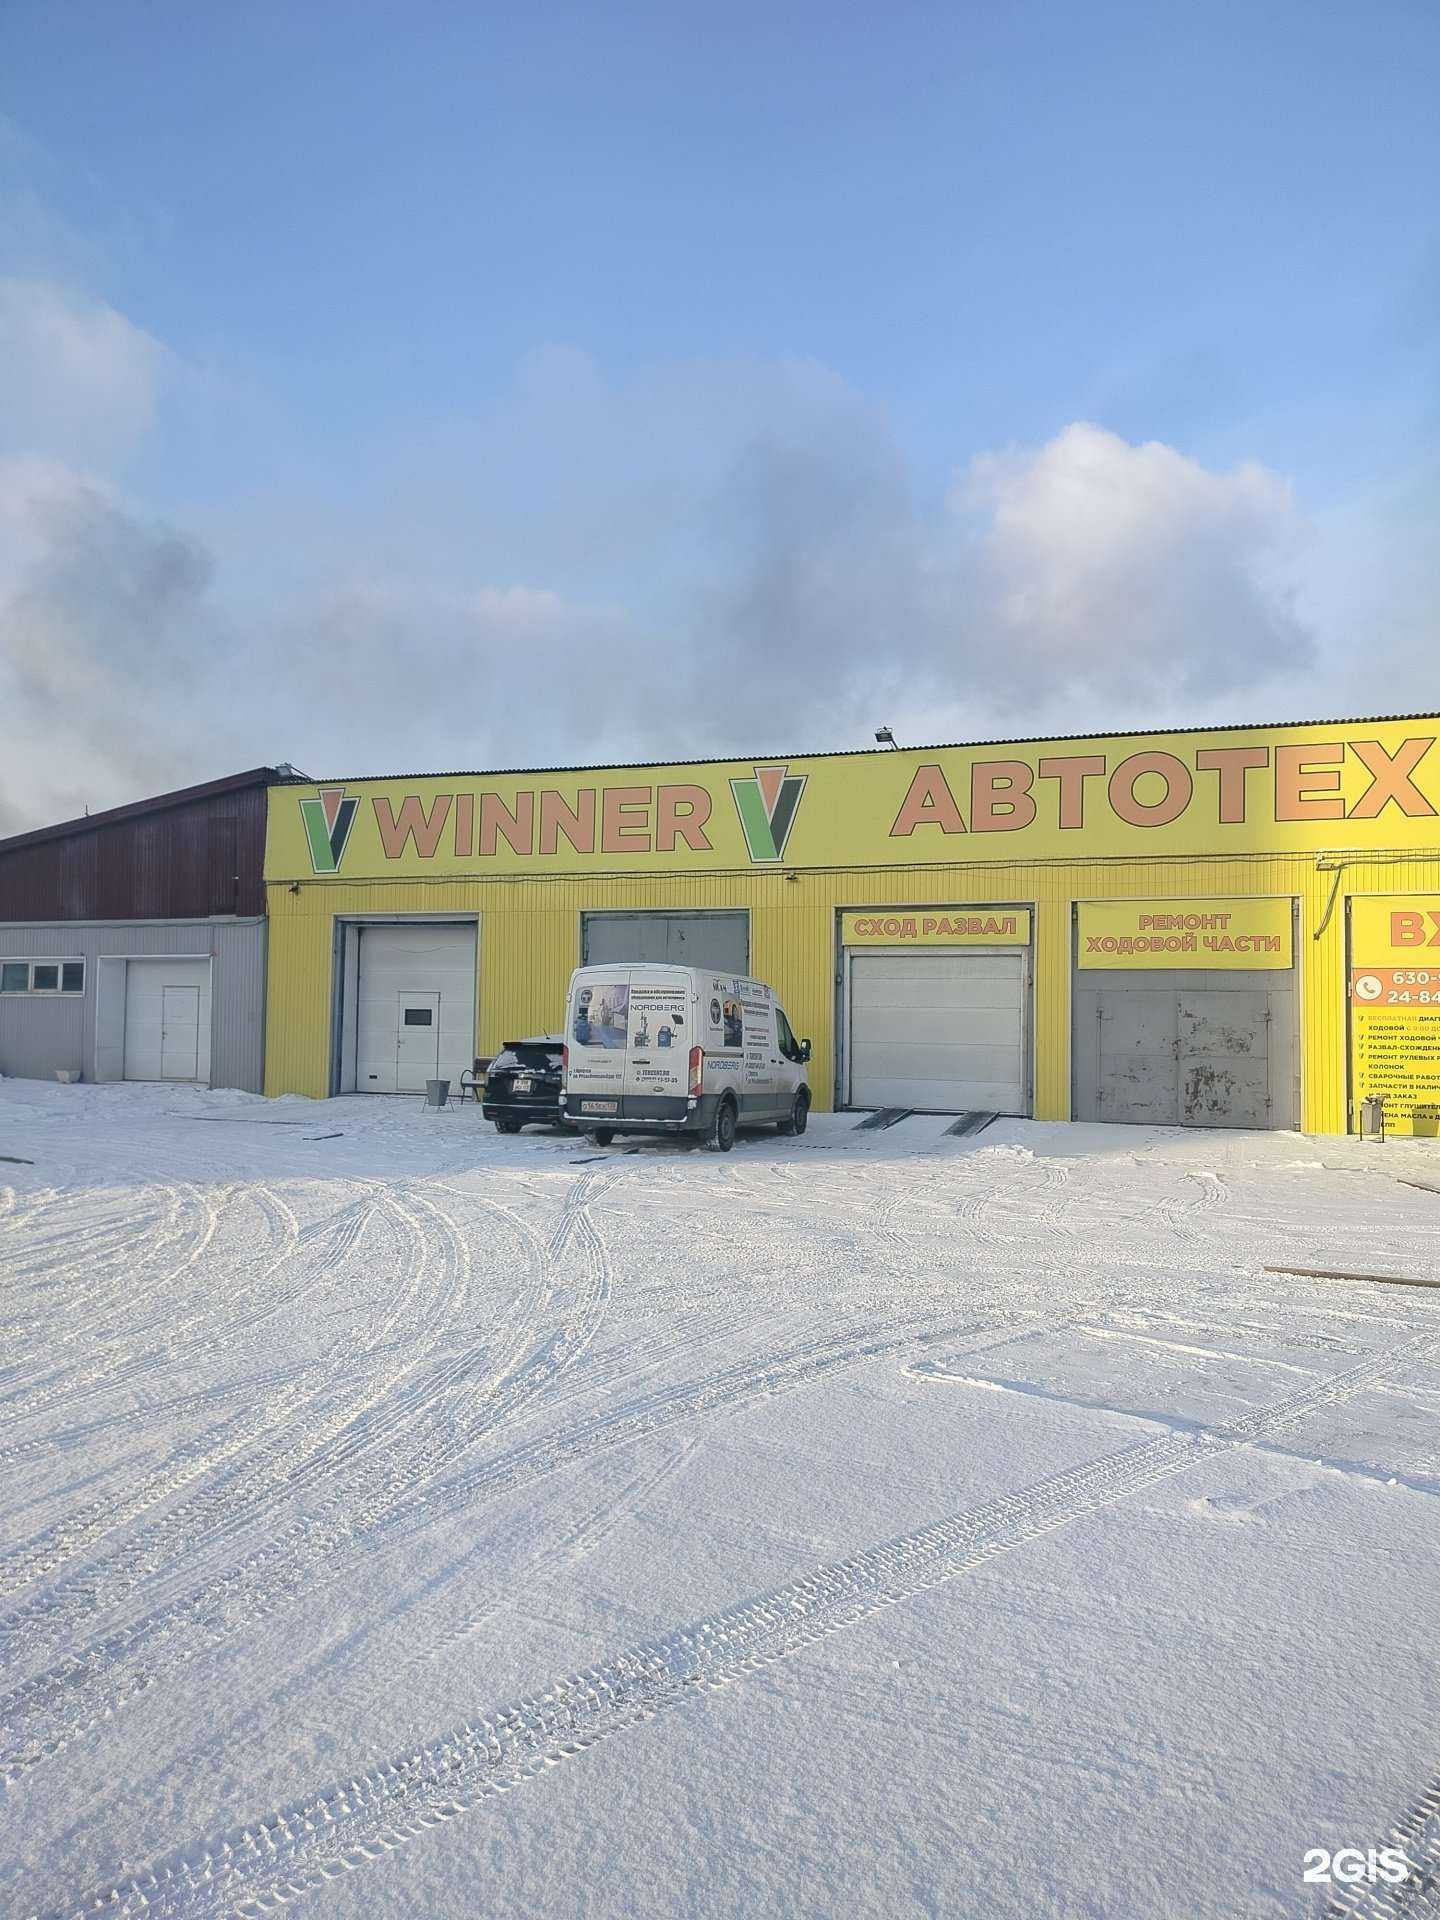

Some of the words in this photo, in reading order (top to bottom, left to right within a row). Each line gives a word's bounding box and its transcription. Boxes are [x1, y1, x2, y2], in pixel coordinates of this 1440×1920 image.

[889, 737, 1439, 837] АВТОТЕХ
[372, 784, 714, 859] WINNER
[854, 918, 918, 938] СХОД
[924, 916, 1017, 936] РАЗВАЛ
[1138, 913, 1232, 931] РЕМОНТ
[1086, 932, 1199, 955] ХОДОВОЙ
[1204, 934, 1281, 953] ЧАСТИ
[630, 1004, 685, 1012] NORDBERG
